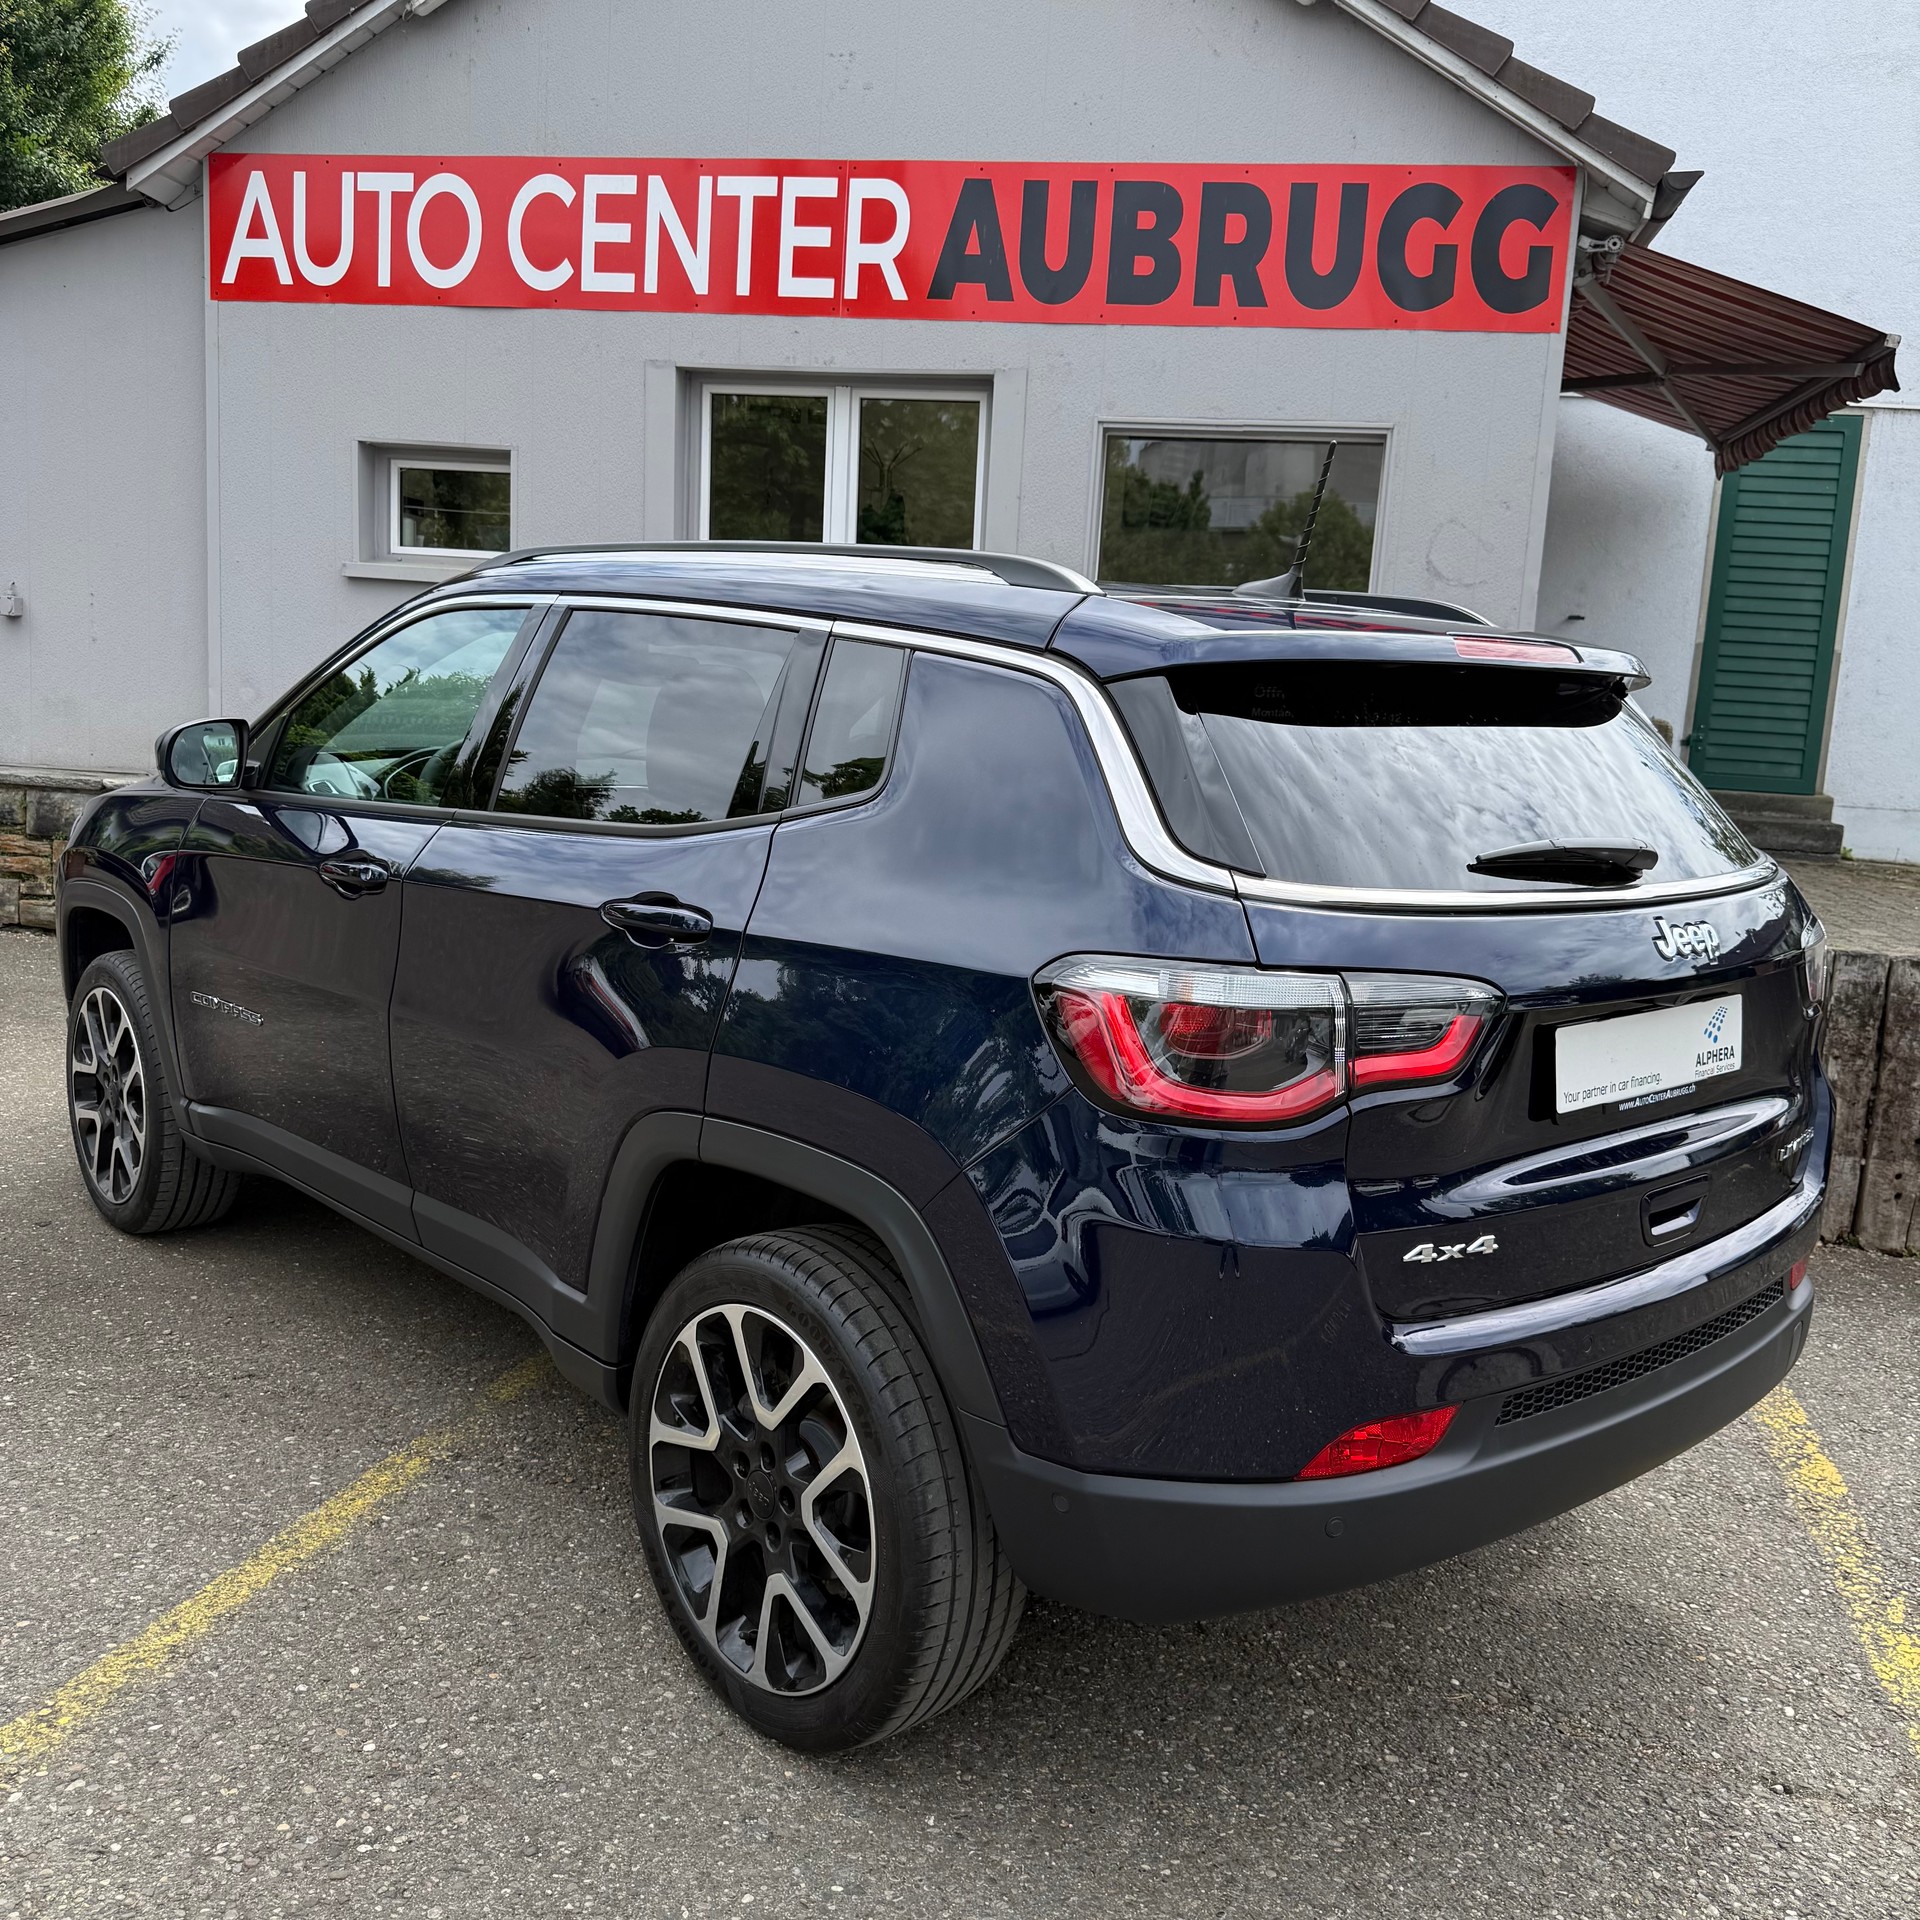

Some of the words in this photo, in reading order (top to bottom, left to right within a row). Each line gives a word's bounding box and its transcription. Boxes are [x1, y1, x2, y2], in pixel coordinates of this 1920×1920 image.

[221, 169, 483, 289] AUTO
[507, 172, 911, 302] CENTER
[926, 177, 1560, 314] AUBRUGG
[1652, 916, 1721, 966] Jeep
[190, 990, 264, 1028] COMPASS
[1694, 1066, 1715, 1079] Financial
[1716, 1062, 1735, 1074] Services
[1695, 1045, 1735, 1068] ALPHERA
[1563, 1091, 1581, 1104] Your
[1582, 1084, 1608, 1102] partner
[1609, 1081, 1617, 1094] in
[1618, 1080, 1629, 1092] car
[1630, 1072, 1663, 1089] financing.
[1402, 1234, 1499, 1264] 4x4
